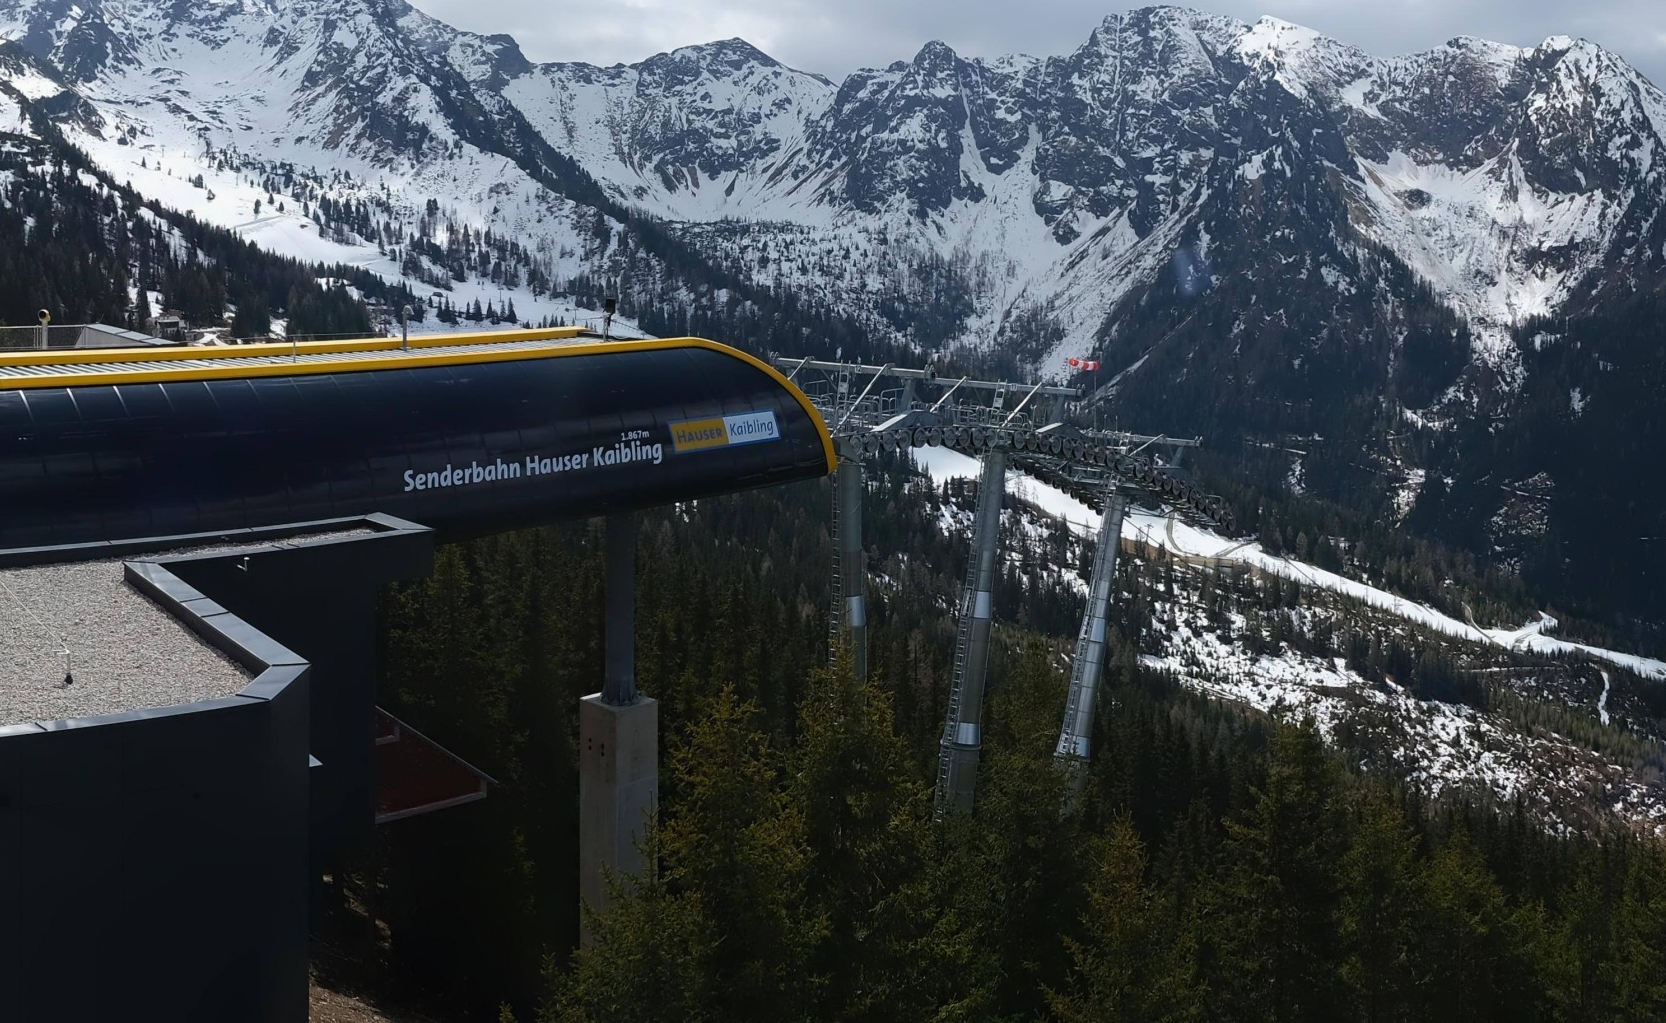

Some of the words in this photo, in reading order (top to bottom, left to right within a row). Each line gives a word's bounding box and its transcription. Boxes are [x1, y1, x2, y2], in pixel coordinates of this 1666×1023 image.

[620, 430, 650, 440] 1.867m
[676, 426, 723, 444] HAUSER
[730, 417, 774, 436] Kaibling
[404, 458, 521, 492] Senderbahn
[526, 452, 589, 476] Hauser
[593, 440, 663, 465] Kaibling
